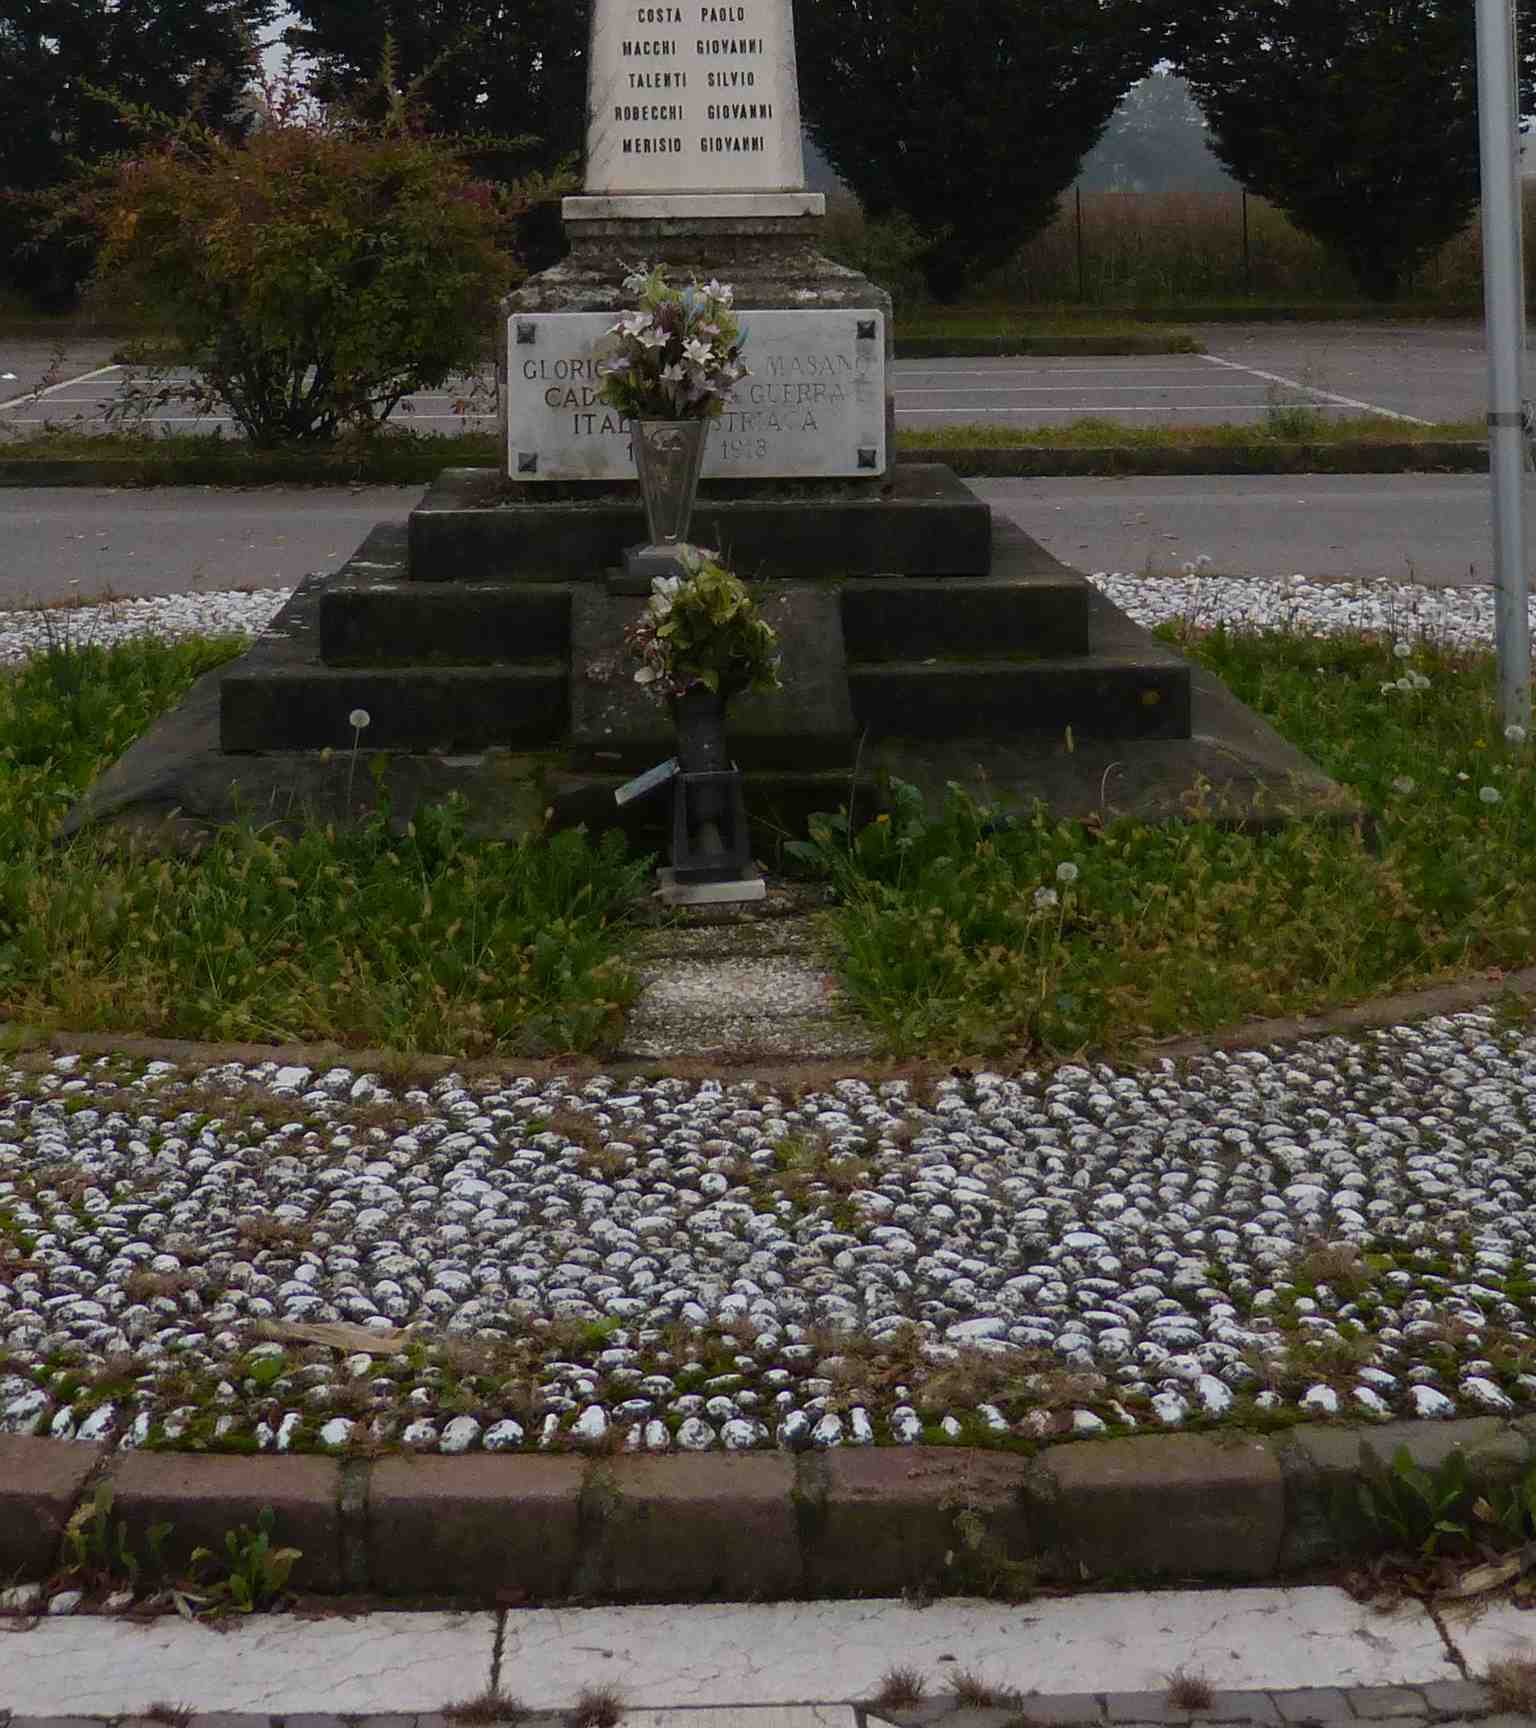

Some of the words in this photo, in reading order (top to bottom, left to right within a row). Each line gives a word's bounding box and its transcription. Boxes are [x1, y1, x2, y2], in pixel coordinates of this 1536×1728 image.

[638, 8, 682, 23] COSTA
[701, 7, 744, 22] PAOLO
[622, 41, 676, 56] MACCHI
[697, 39, 762, 54] GIOVANNI
[629, 72, 686, 88] TALENTI
[708, 72, 754, 87] SILVIO
[615, 106, 682, 121] ROBECCHI
[708, 104, 772, 119] GIOVANNI
[622, 138, 681, 153] MERISIO
[700, 136, 763, 152] GIOVANNI
[750, 383, 845, 404] GUERRA
[574, 414, 633, 435] ITAL
